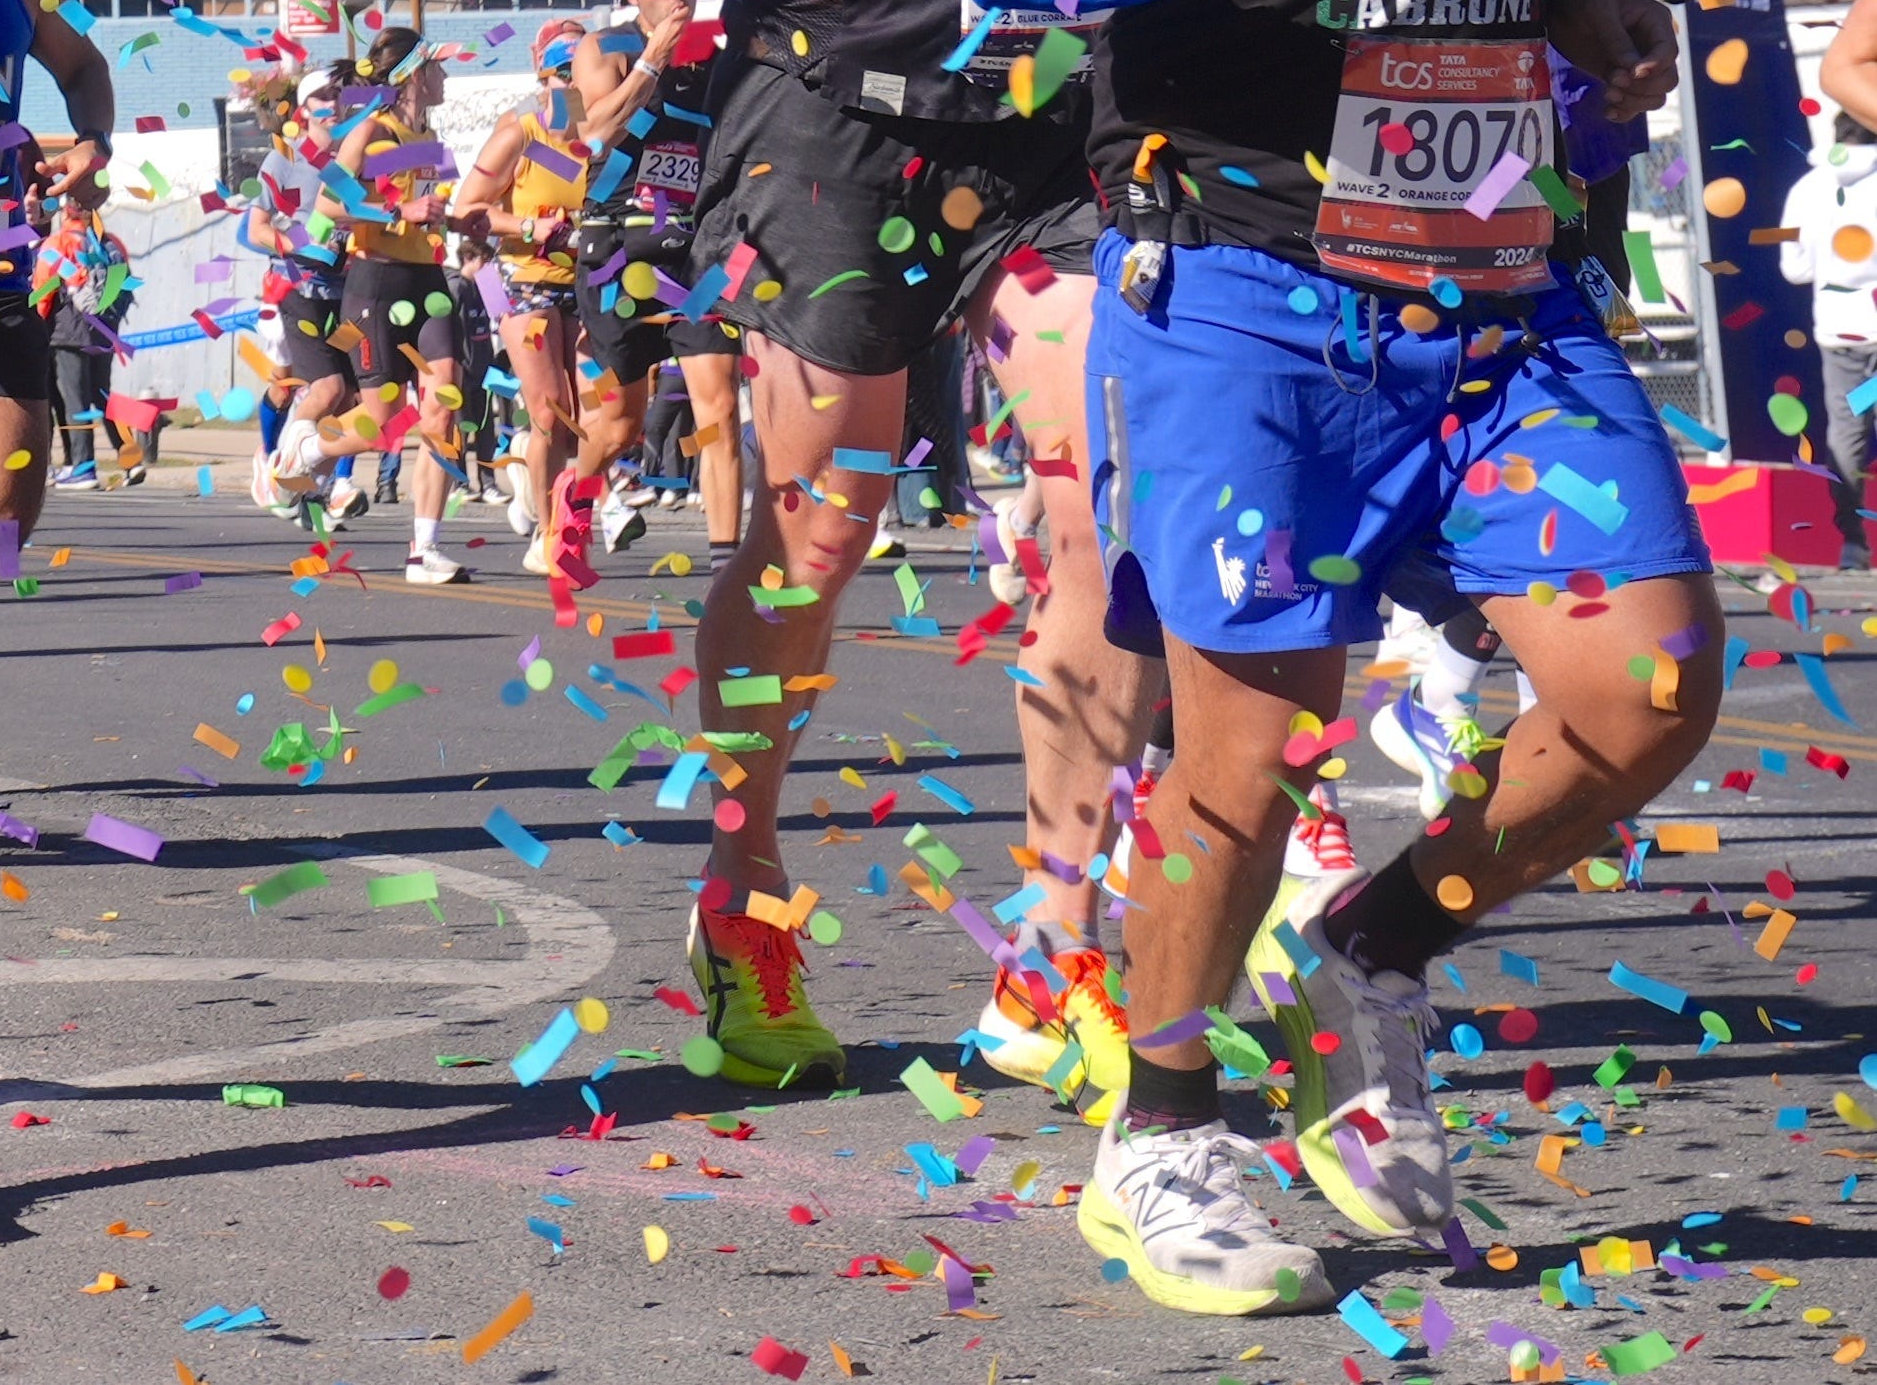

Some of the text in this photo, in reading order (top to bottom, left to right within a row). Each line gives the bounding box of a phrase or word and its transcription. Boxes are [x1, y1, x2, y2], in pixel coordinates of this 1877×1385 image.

[1381, 51, 1433, 90] tcs
[1439, 55, 1466, 66] TATA
[1438, 67, 1501, 78] CONSULTANCY
[1437, 80, 1477, 91] SERVICES
[1363, 106, 1542, 183] 18070
[1337, 181, 1373, 194] WAVE
[1377, 183, 1389, 198] 2
[1399, 188, 1449, 201] ORANGE
[1346, 243, 1457, 264] #TCSNYCMarathon
[1494, 246, 1535, 267] 2024
